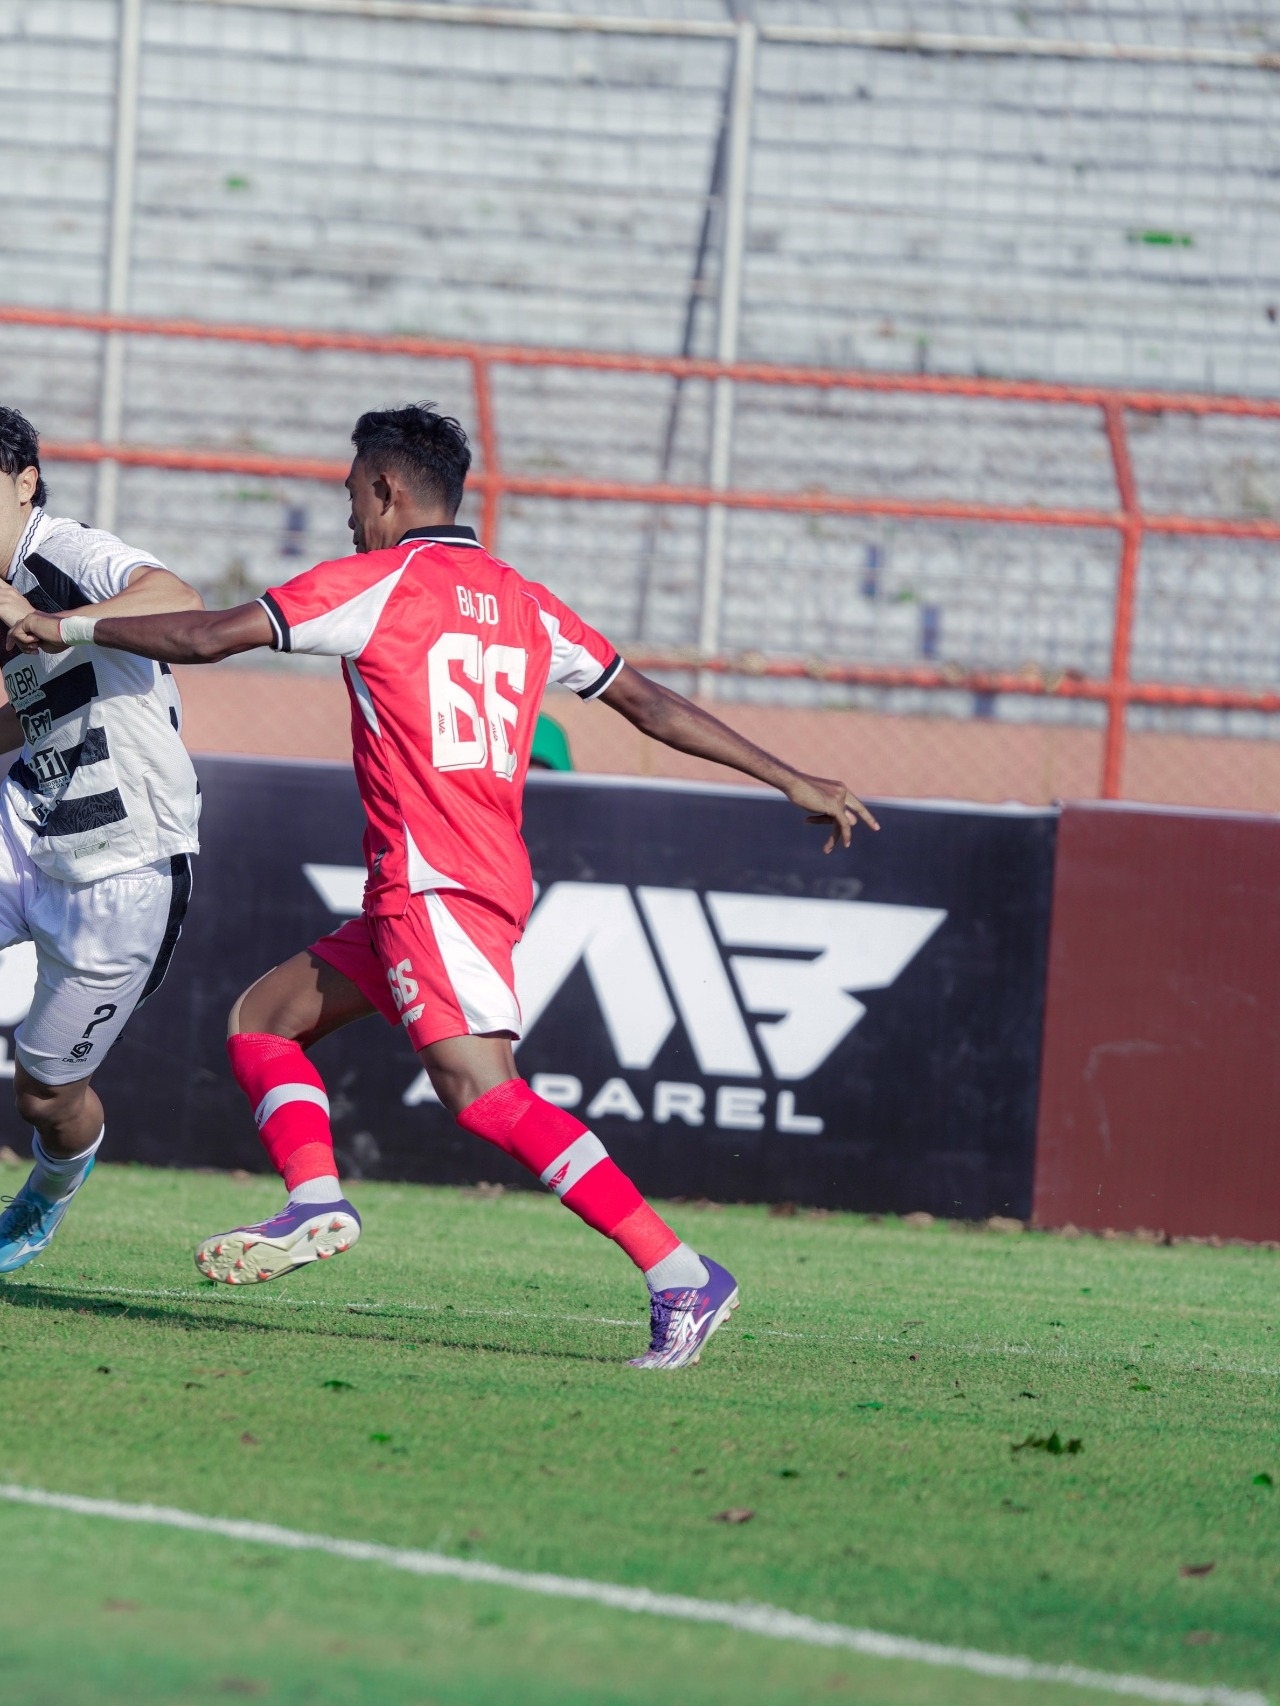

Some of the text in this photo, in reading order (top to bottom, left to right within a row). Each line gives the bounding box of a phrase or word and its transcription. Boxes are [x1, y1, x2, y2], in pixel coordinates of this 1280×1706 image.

[14, 664, 39, 695] BRI
[428, 631, 529, 783] 66
[387, 958, 420, 1012] 66
[402, 1069, 824, 1134] PAREL
